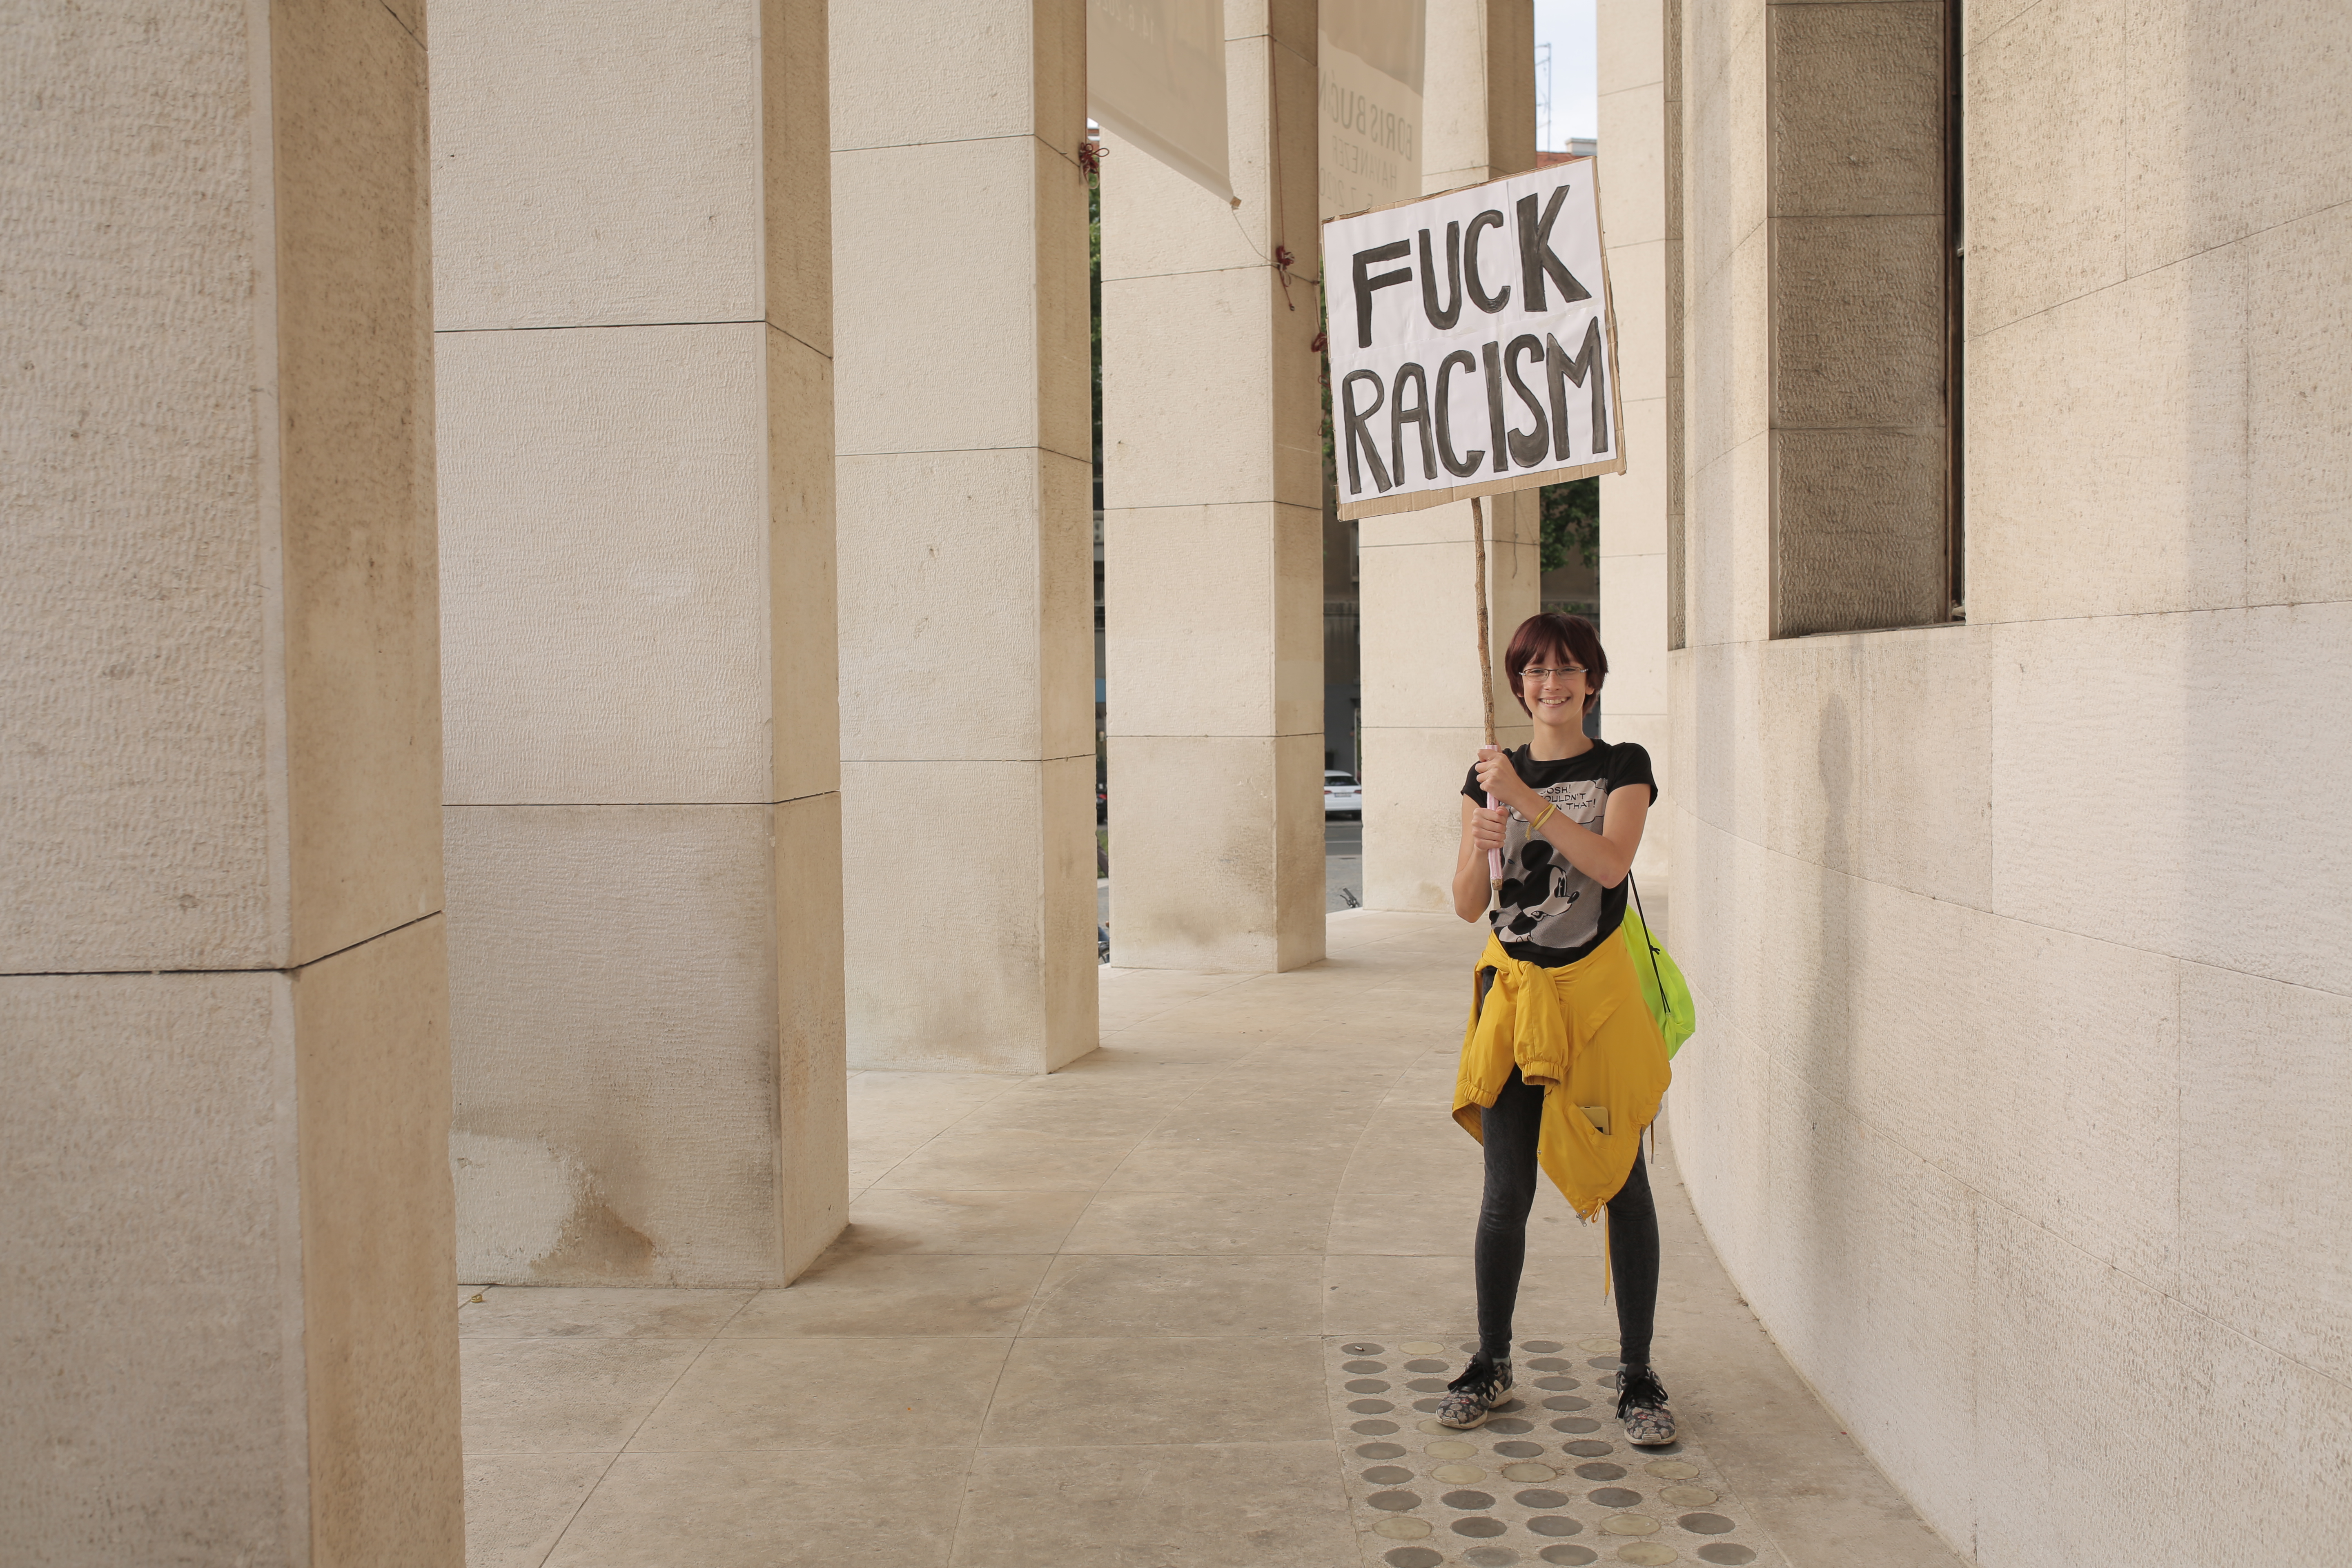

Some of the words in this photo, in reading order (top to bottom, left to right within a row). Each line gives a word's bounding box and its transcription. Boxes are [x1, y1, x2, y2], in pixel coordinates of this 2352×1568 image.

[1353, 185, 1592, 348] FUCK
[1342, 316, 1608, 495] RACISM
[1541, 793, 1586, 802] OULDN'T
[1566, 798, 1596, 810] THAT!
